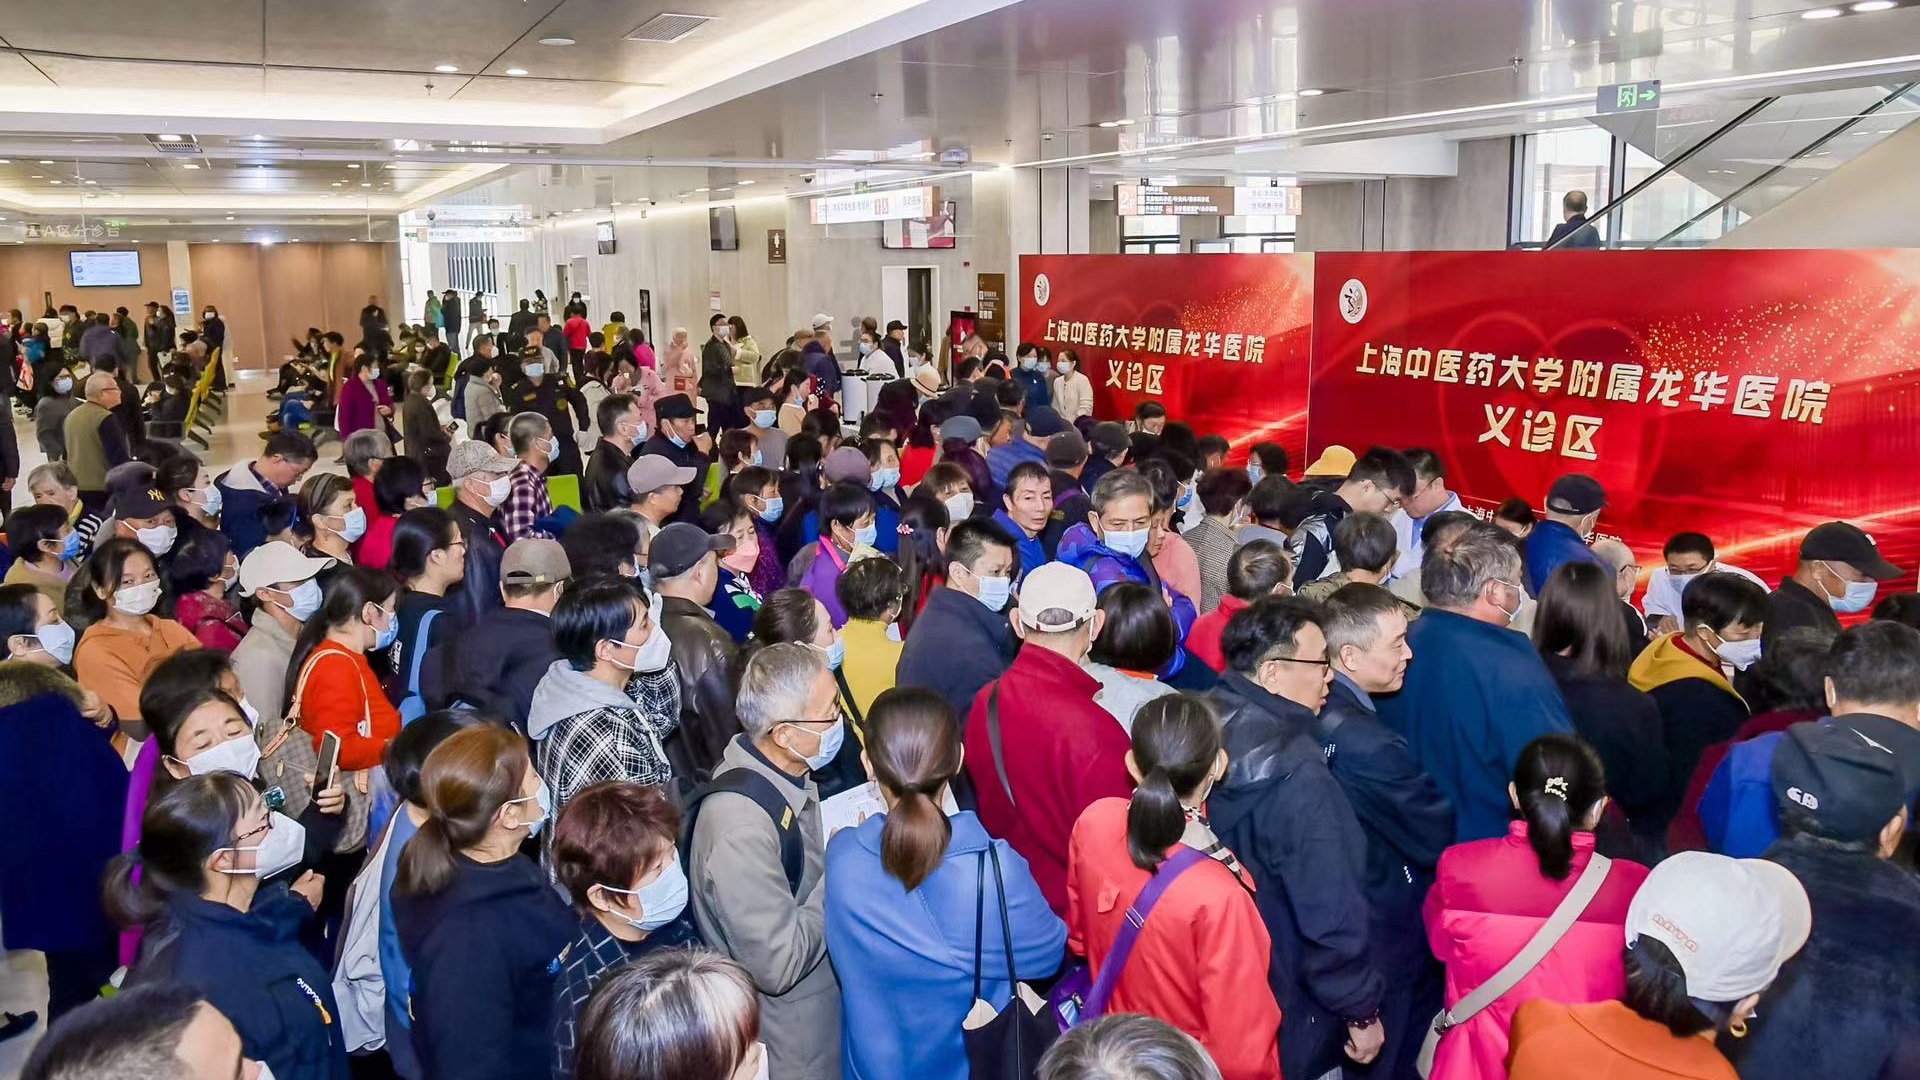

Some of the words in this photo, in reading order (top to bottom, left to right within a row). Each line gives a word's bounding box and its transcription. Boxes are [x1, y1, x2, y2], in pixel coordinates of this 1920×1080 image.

[1043, 318, 1266, 363] 上海中医药大学附属龙华医院
[1105, 359, 1166, 395] 义诊区
[1355, 342, 1831, 424] 上海中医药大学附属龙华医院
[1478, 403, 1603, 461] 义诊区
